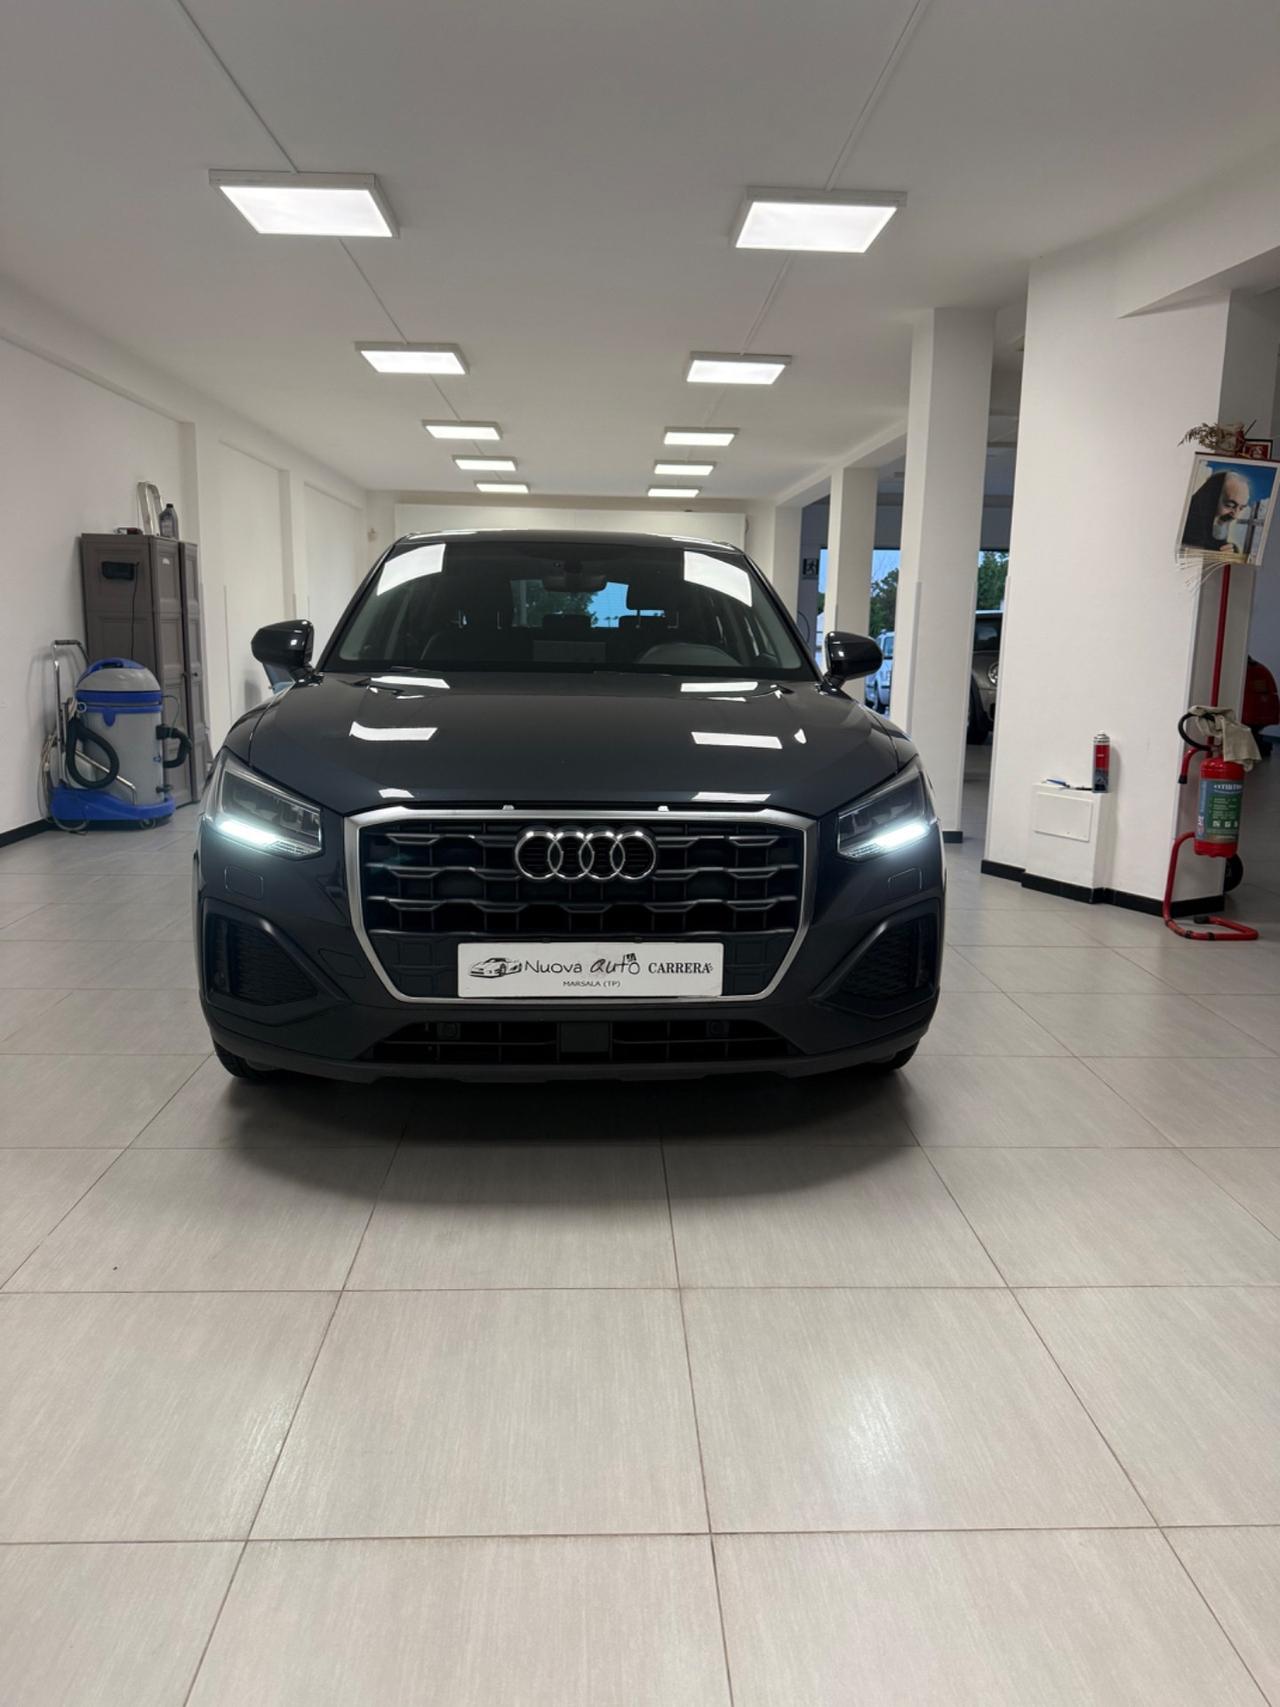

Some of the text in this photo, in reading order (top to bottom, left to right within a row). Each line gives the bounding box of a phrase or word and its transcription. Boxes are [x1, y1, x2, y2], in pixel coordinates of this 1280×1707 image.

[525, 959, 583, 974] Nuova
[648, 962, 711, 974] CARRERA
[563, 980, 621, 988] MARSALA (TP)
